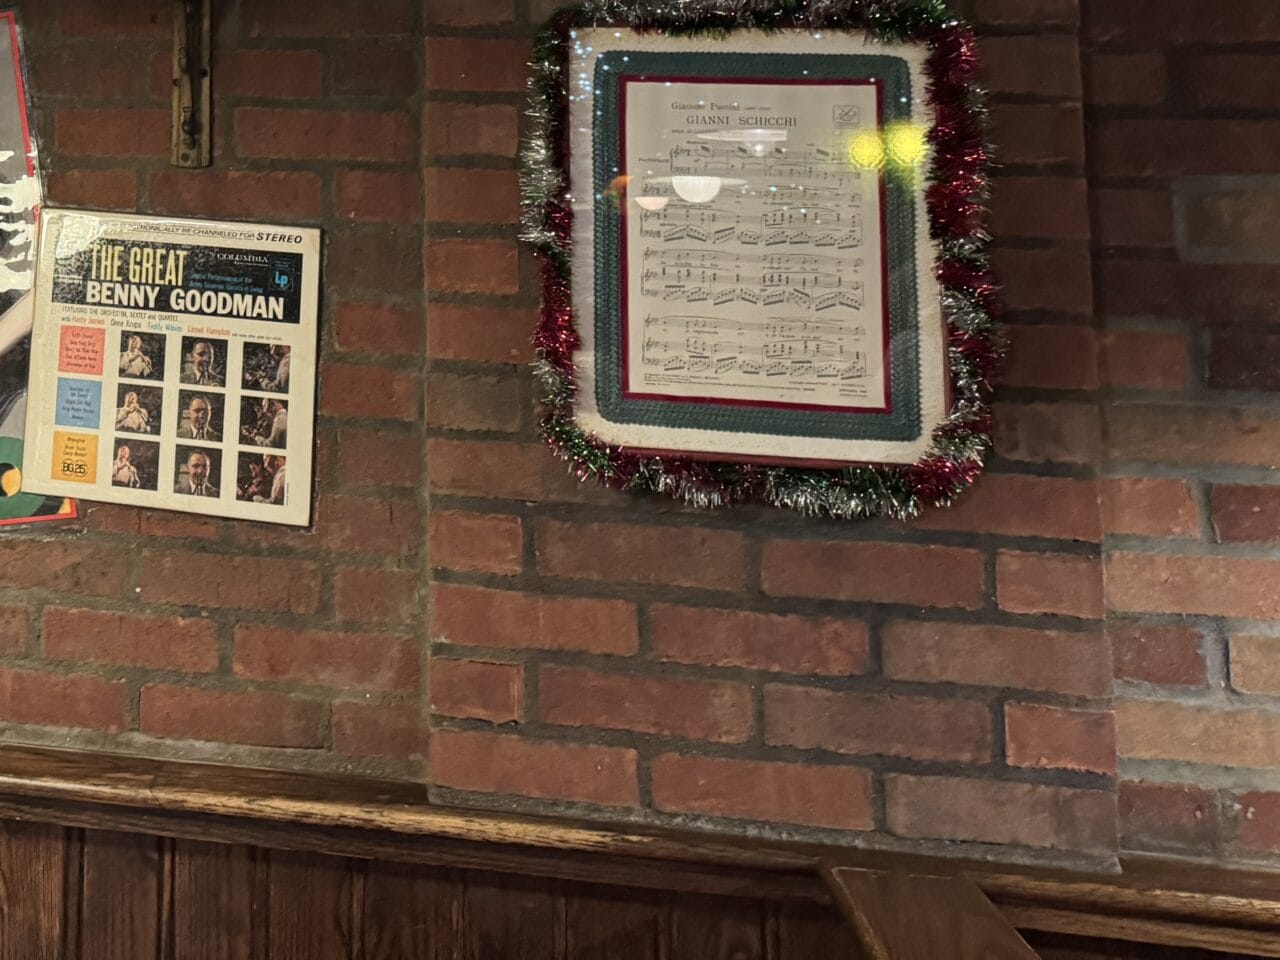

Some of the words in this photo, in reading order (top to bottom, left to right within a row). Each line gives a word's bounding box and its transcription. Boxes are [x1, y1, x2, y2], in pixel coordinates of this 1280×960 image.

[686, 116, 730, 125] GIANNI
[738, 116, 797, 127] SCHICCHI
[256, 232, 303, 245] STEREO
[90, 242, 124, 282] THE
[128, 246, 188, 287] GREAT
[217, 252, 269, 264] COLUMBIA
[86, 281, 160, 309] BENNY
[170, 288, 284, 321] GOODMAN
